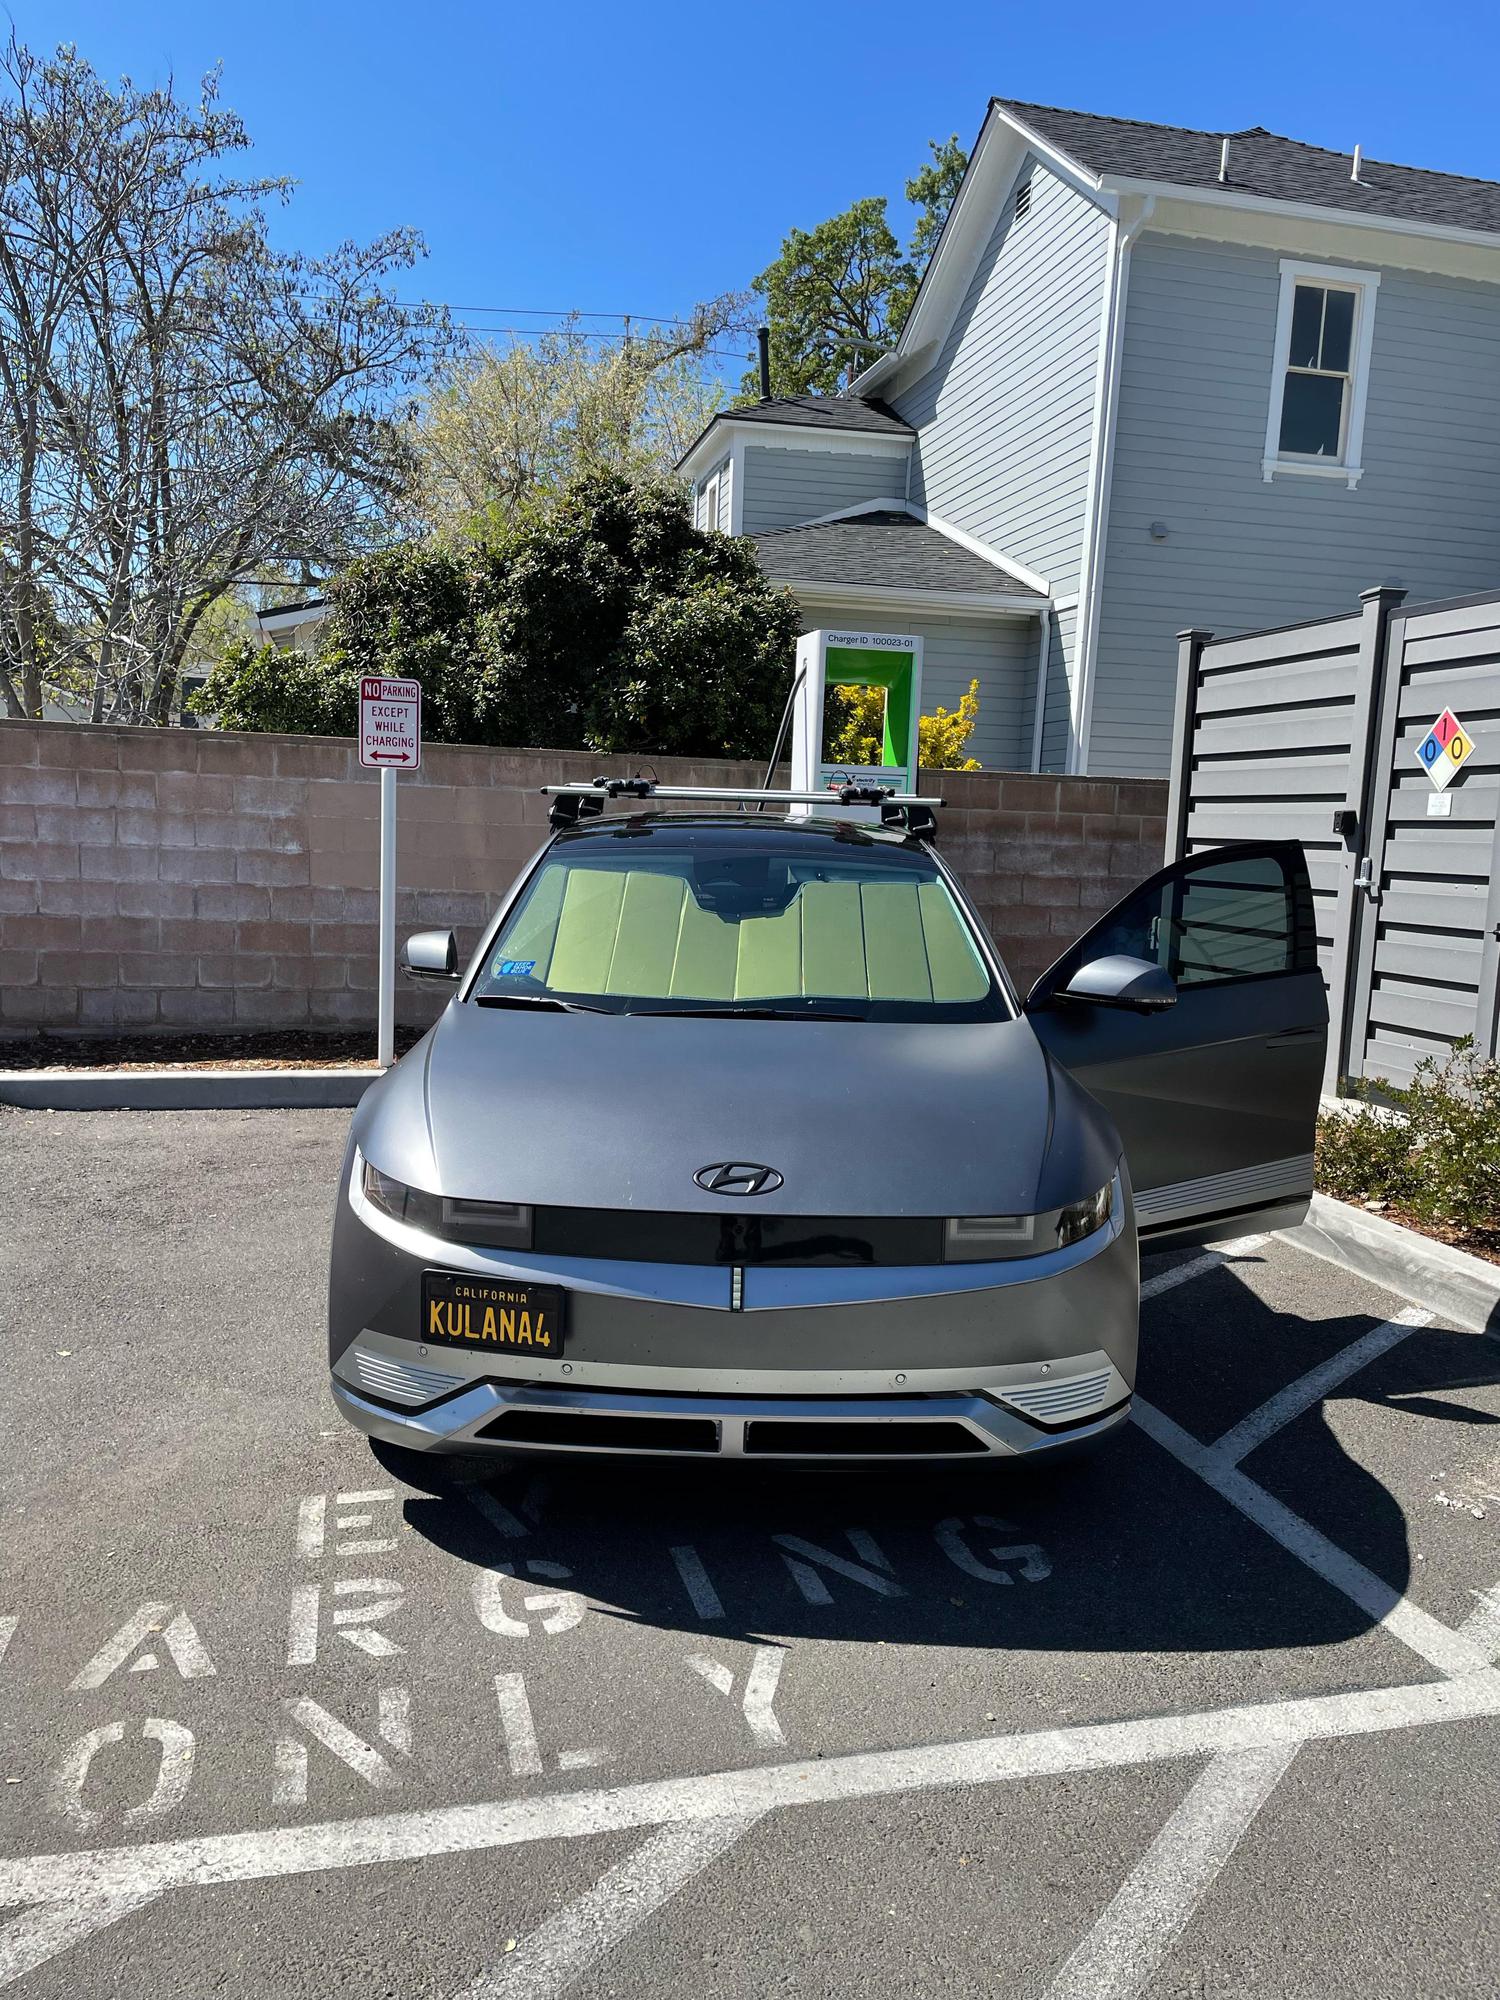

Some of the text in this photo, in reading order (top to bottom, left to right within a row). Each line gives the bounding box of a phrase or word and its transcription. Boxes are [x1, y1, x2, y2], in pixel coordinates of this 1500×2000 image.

[828, 634, 913, 647] Charger ID 100023-01
[364, 682, 416, 698] NO PARKING
[371, 706, 409, 718] EXCEPT
[375, 721, 405, 733] WHILE
[1442, 717, 1448, 741] 1
[366, 735, 414, 748] CHARGING
[1424, 739, 1436, 762] 0
[1451, 736, 1463, 760] 0
[455, 1286, 527, 1304] CALIFORNIA
[429, 1300, 551, 1348] KULANA4
[0, 1514, 1053, 1692] ARGING
[49, 1645, 788, 1834] ONLY
